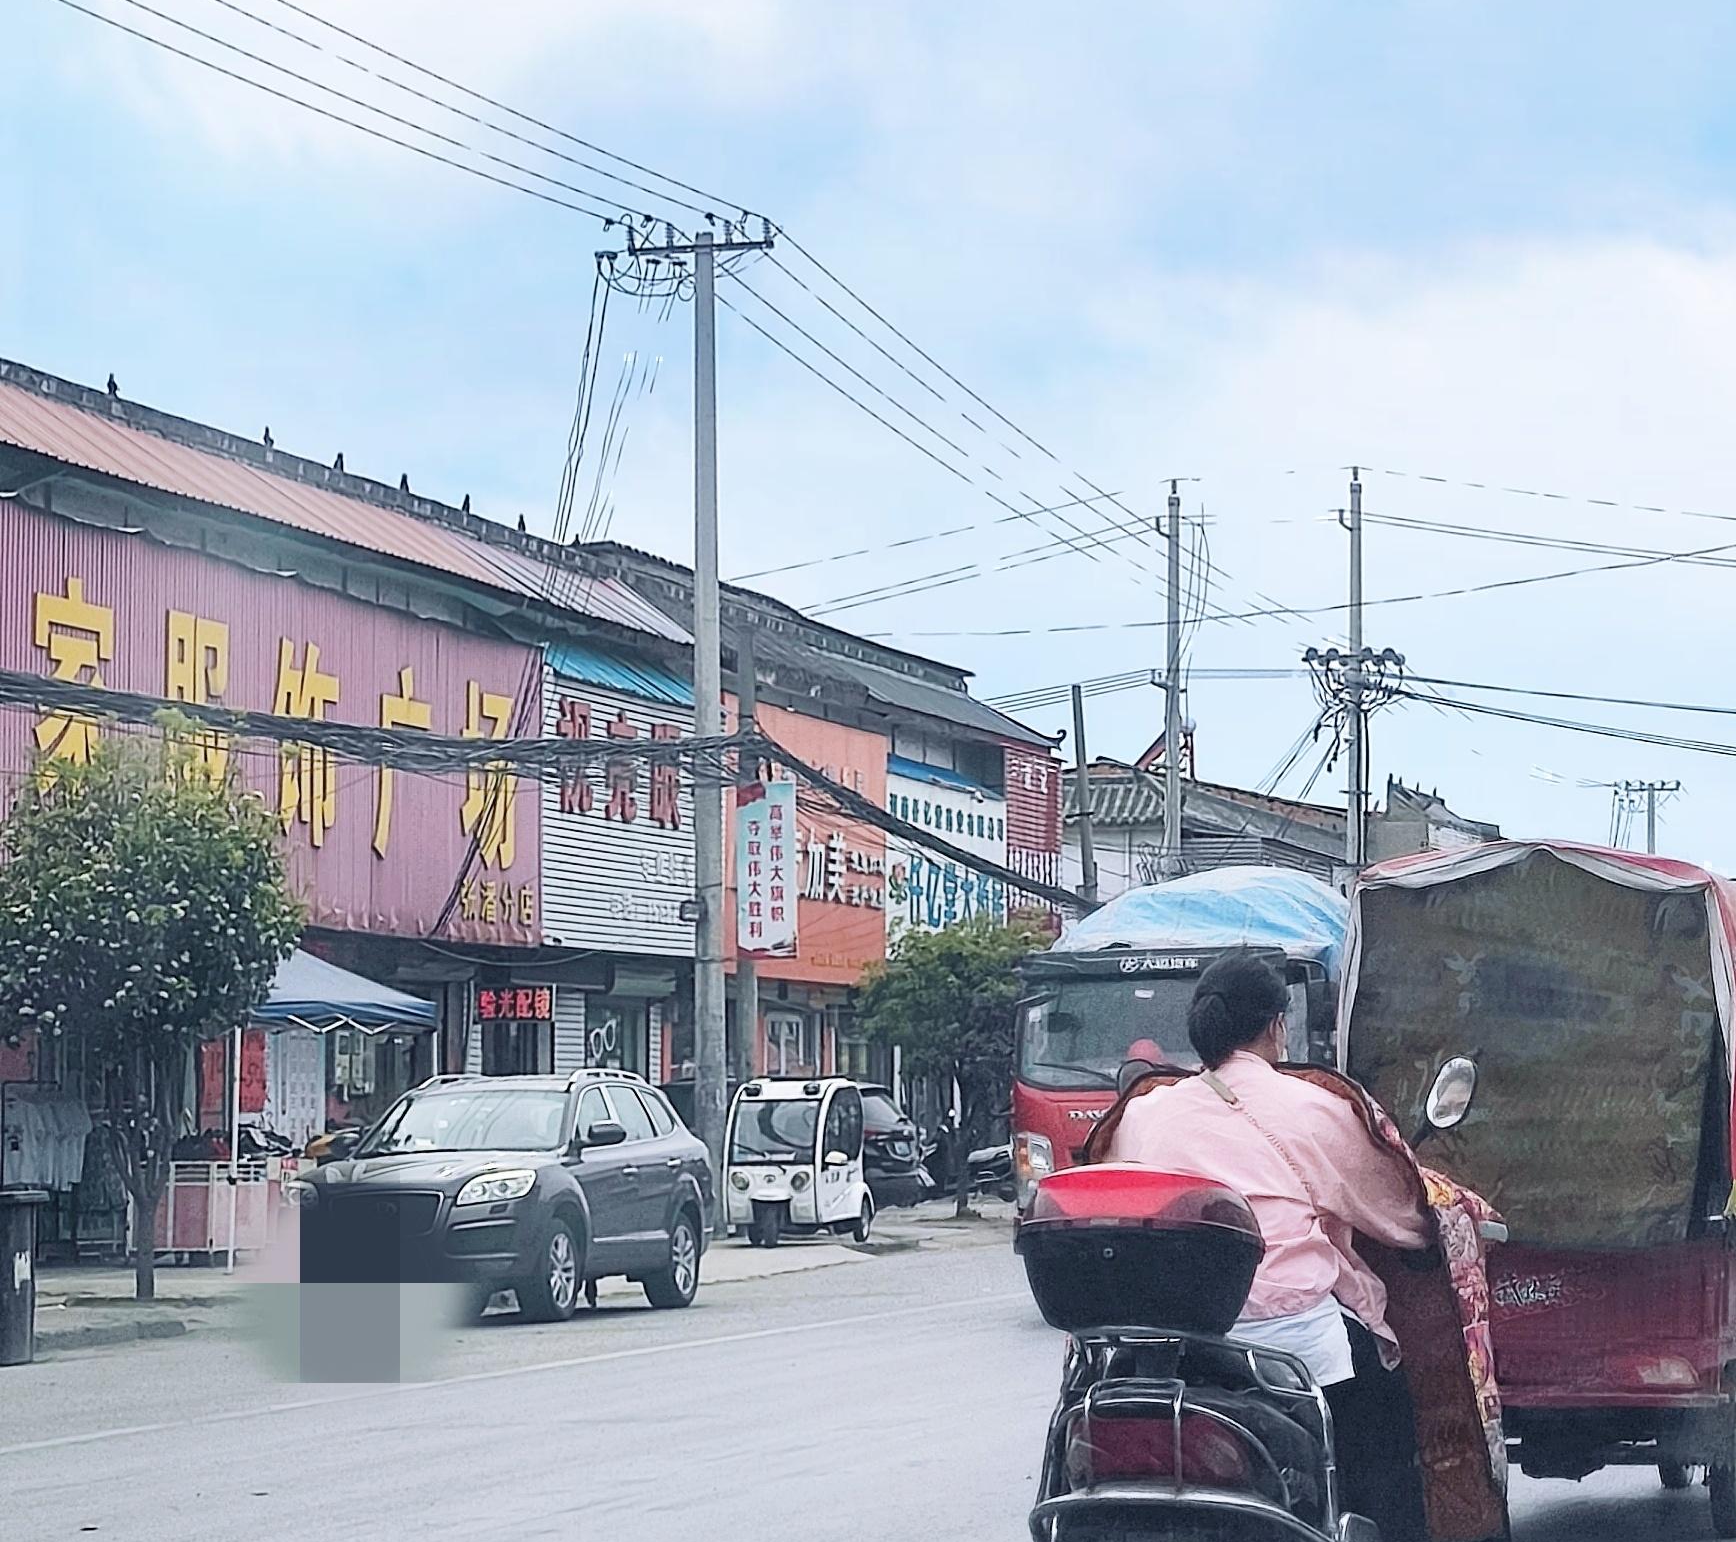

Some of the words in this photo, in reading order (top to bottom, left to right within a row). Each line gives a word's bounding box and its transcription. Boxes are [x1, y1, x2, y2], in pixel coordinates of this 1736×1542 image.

[747, 820, 762, 939] 夺取伟大胜利
[768, 804, 785, 923] 高举伟大旗帜
[797, 826, 847, 904] 加美
[479, 986, 551, 1020] 验光配镜
